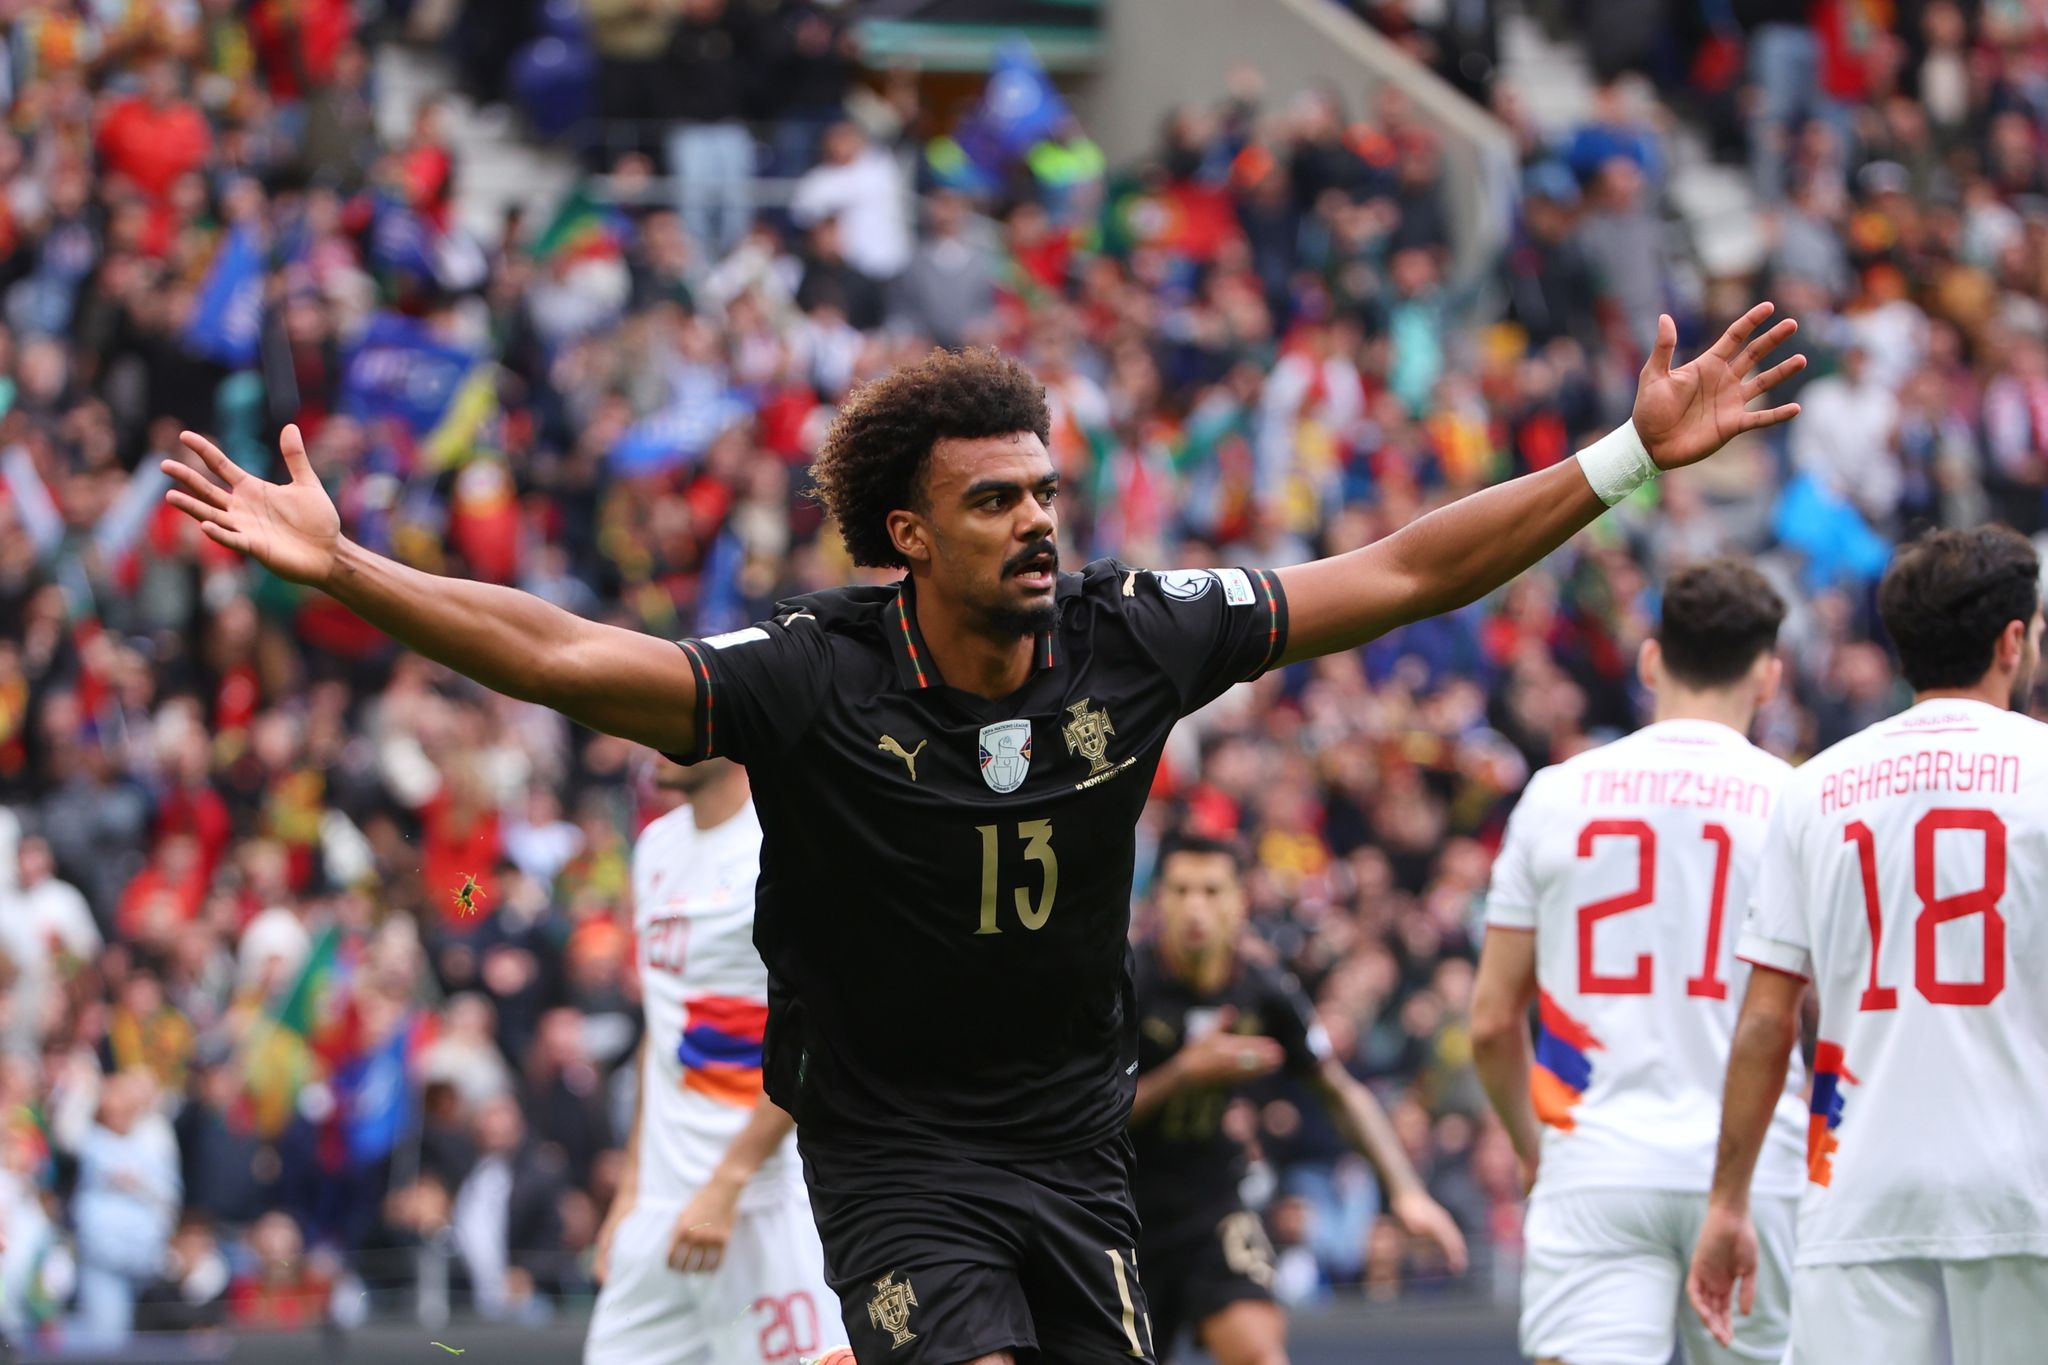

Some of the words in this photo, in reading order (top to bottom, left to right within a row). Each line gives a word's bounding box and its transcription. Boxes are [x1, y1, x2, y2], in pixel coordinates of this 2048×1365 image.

[1581, 768, 1770, 819] TIKNIZYAN
[1821, 750, 2020, 815] AGHASARYAN
[974, 818, 1058, 935] 13
[1576, 818, 1731, 1001] 21
[1844, 808, 2007, 1011] 18
[752, 1290, 819, 1363] 20
[1104, 1249, 1154, 1357] 1
